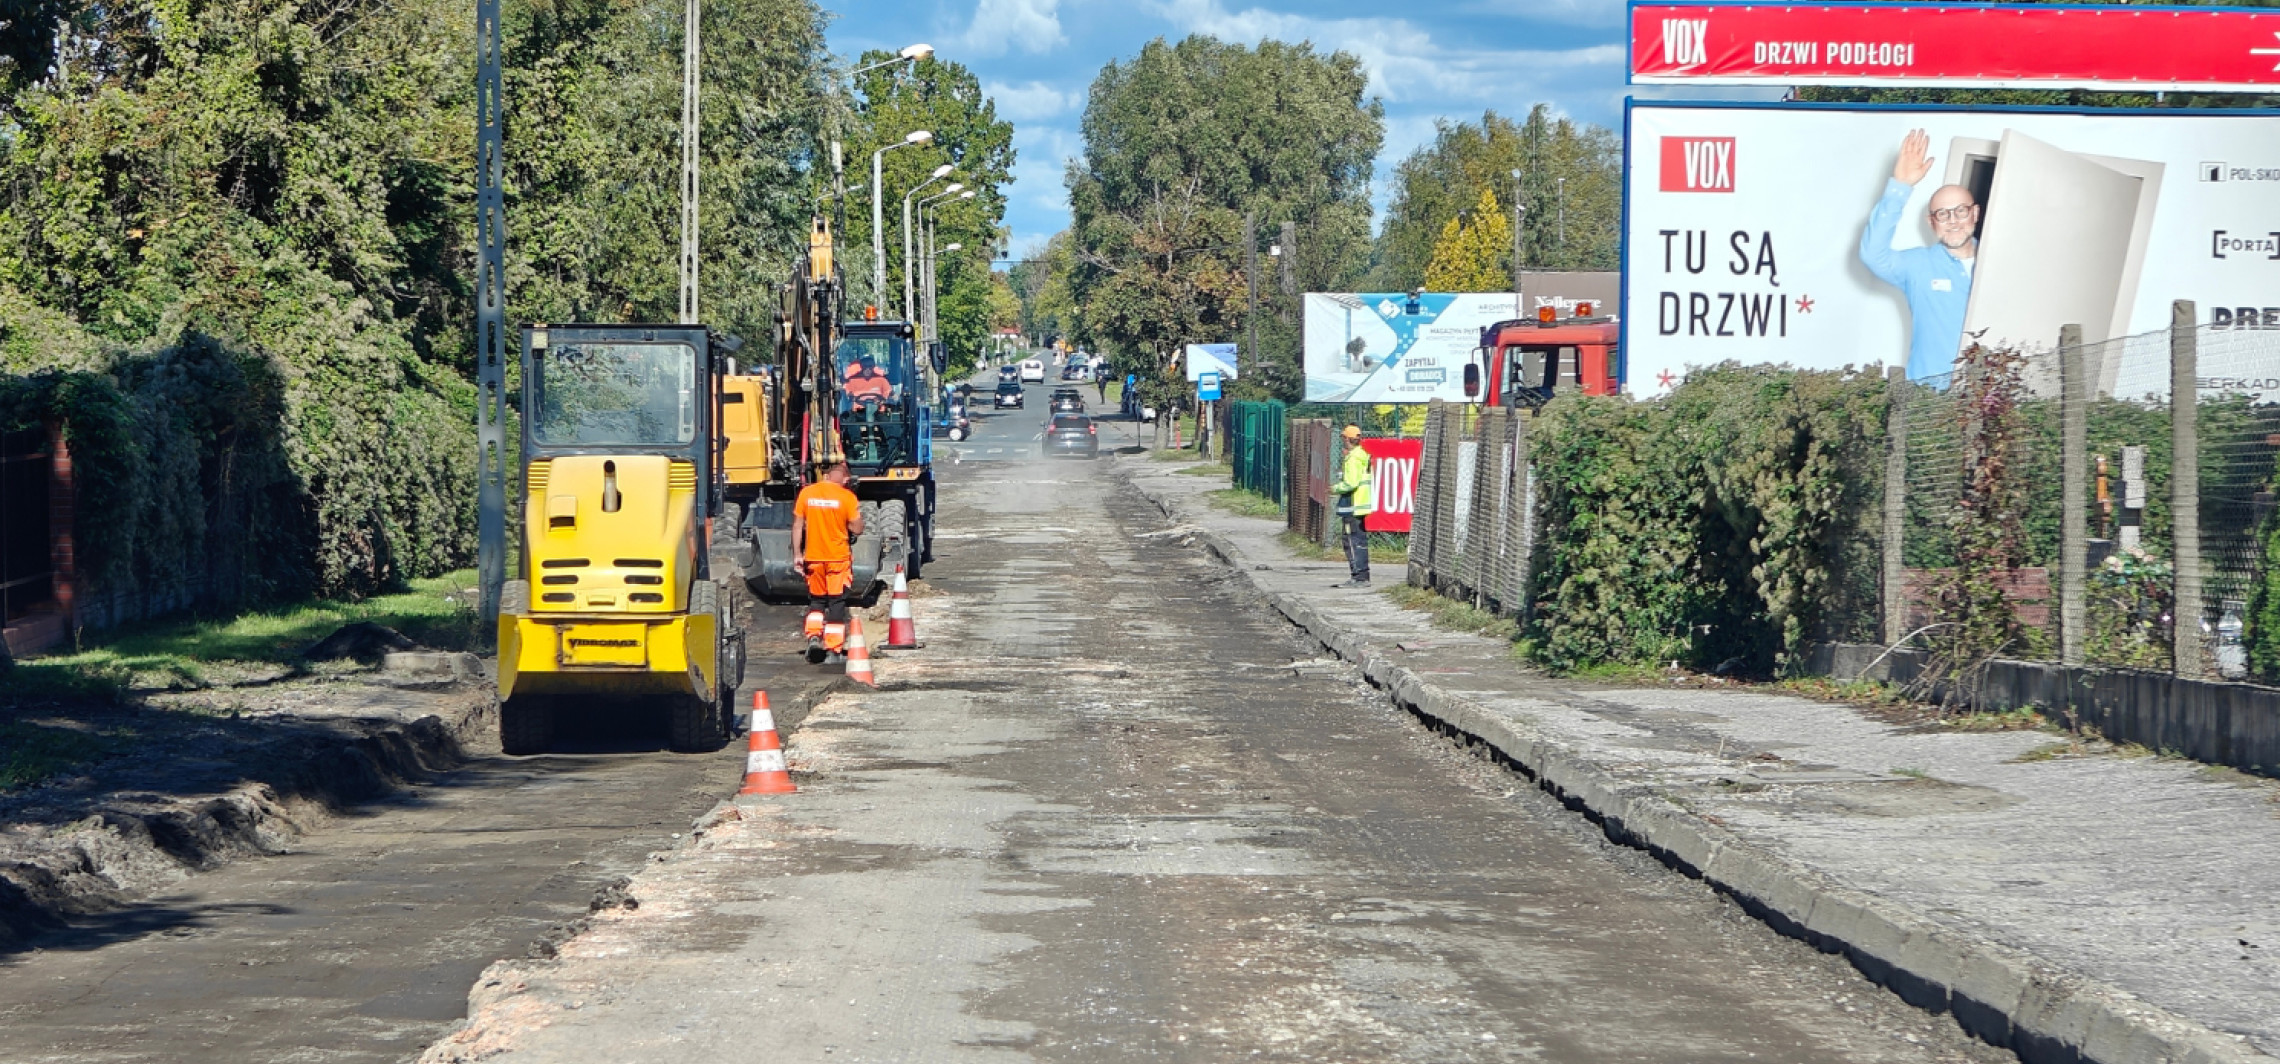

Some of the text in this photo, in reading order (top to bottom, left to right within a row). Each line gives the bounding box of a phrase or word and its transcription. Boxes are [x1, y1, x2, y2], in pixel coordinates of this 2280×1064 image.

[1661, 18, 1708, 65] VOX
[1754, 41, 1915, 67] DRZWI PODŁOGI
[1683, 140, 1731, 189] VOX
[1658, 229, 1780, 287] TU SĄ
[1370, 456, 1415, 514] VOX
